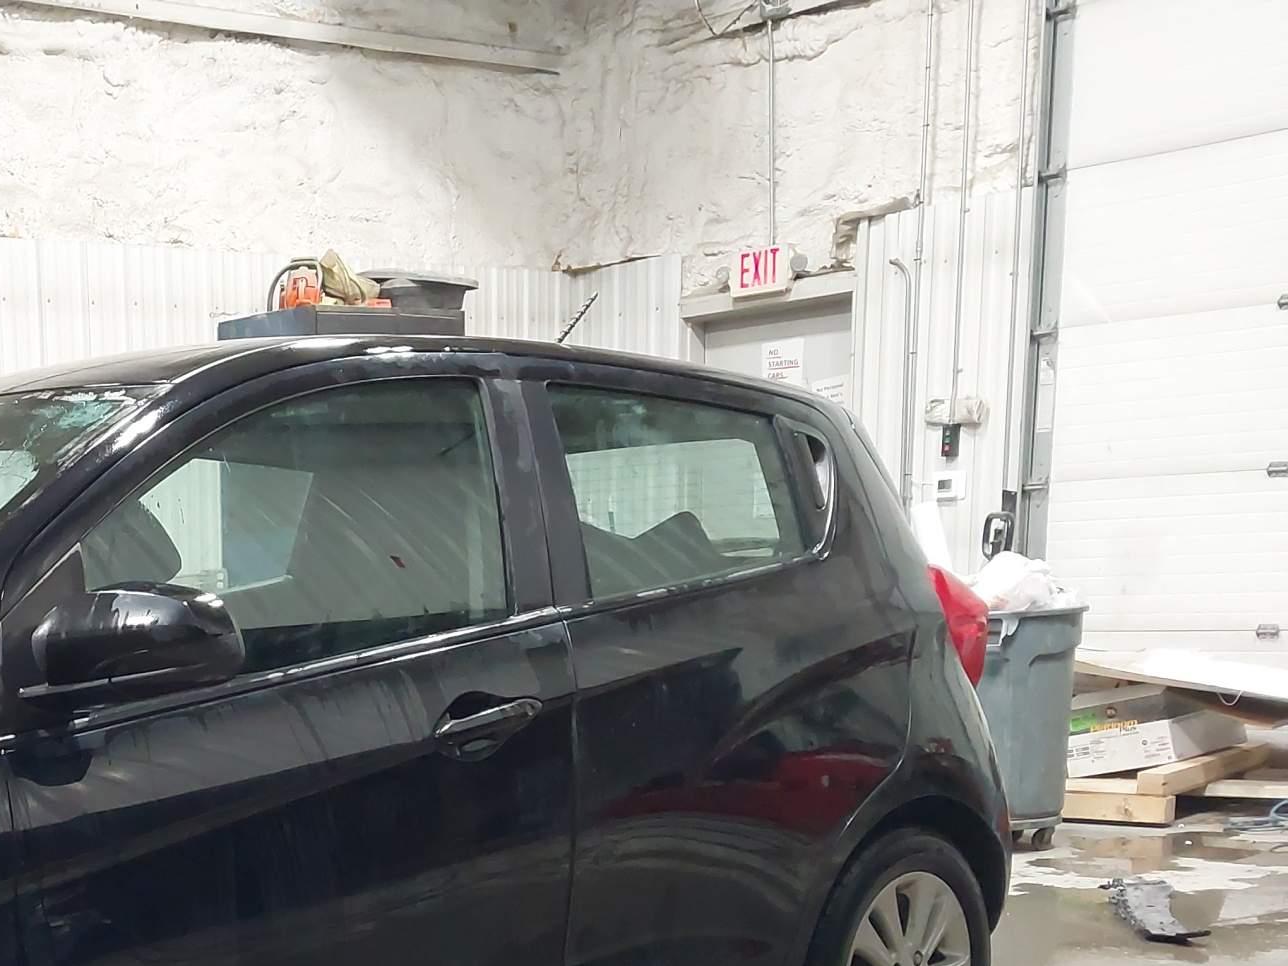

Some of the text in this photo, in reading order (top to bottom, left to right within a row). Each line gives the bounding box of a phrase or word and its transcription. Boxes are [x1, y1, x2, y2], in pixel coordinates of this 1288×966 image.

[740, 247, 780, 289] EXIT
[768, 348, 779, 357] NO
[768, 358, 799, 368] STARTING
